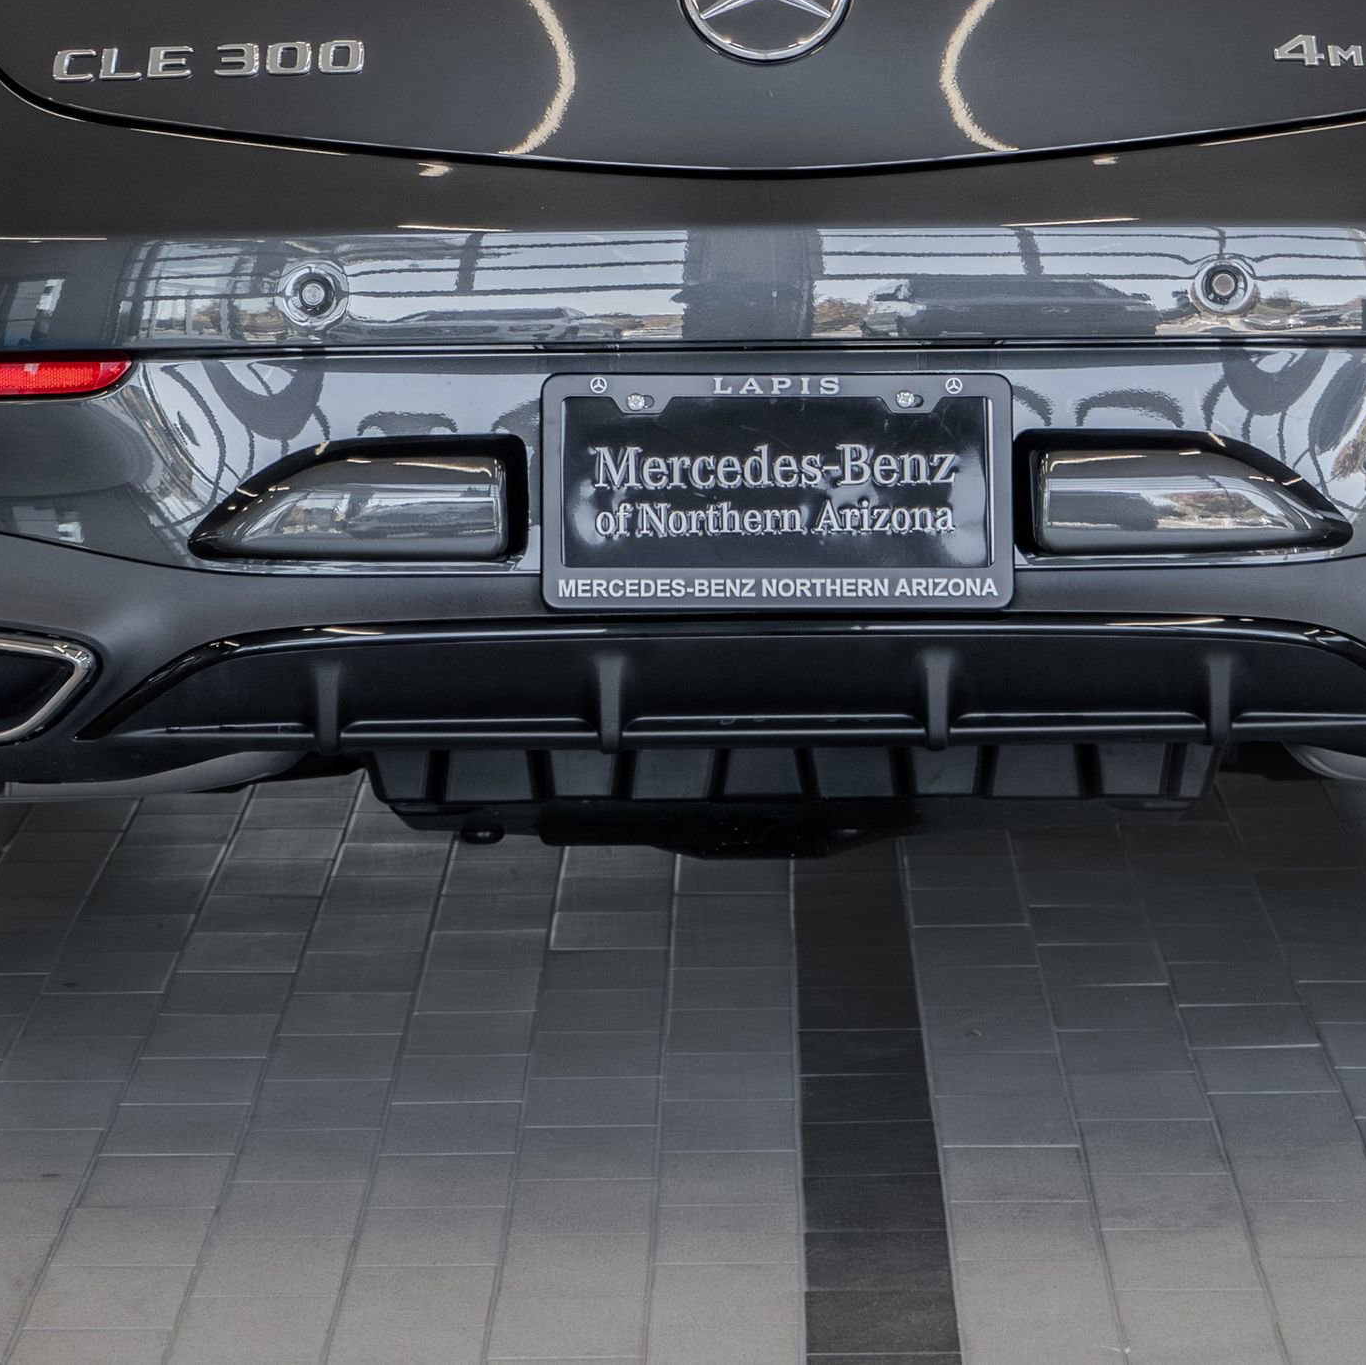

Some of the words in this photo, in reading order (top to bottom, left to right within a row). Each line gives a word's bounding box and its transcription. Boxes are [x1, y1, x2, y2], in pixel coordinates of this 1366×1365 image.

[52, 45, 194, 81] CLE
[214, 39, 365, 77] 300
[713, 377, 840, 395] LAPIS
[593, 443, 956, 489] Mercedes-Benz
[595, 502, 633, 537] of
[636, 500, 805, 538] Northern
[812, 498, 956, 535] Arizona
[558, 578, 756, 598] MERCEDES-BENZ
[761, 578, 889, 598] NORTHERN
[894, 577, 999, 598] ARIZONA
